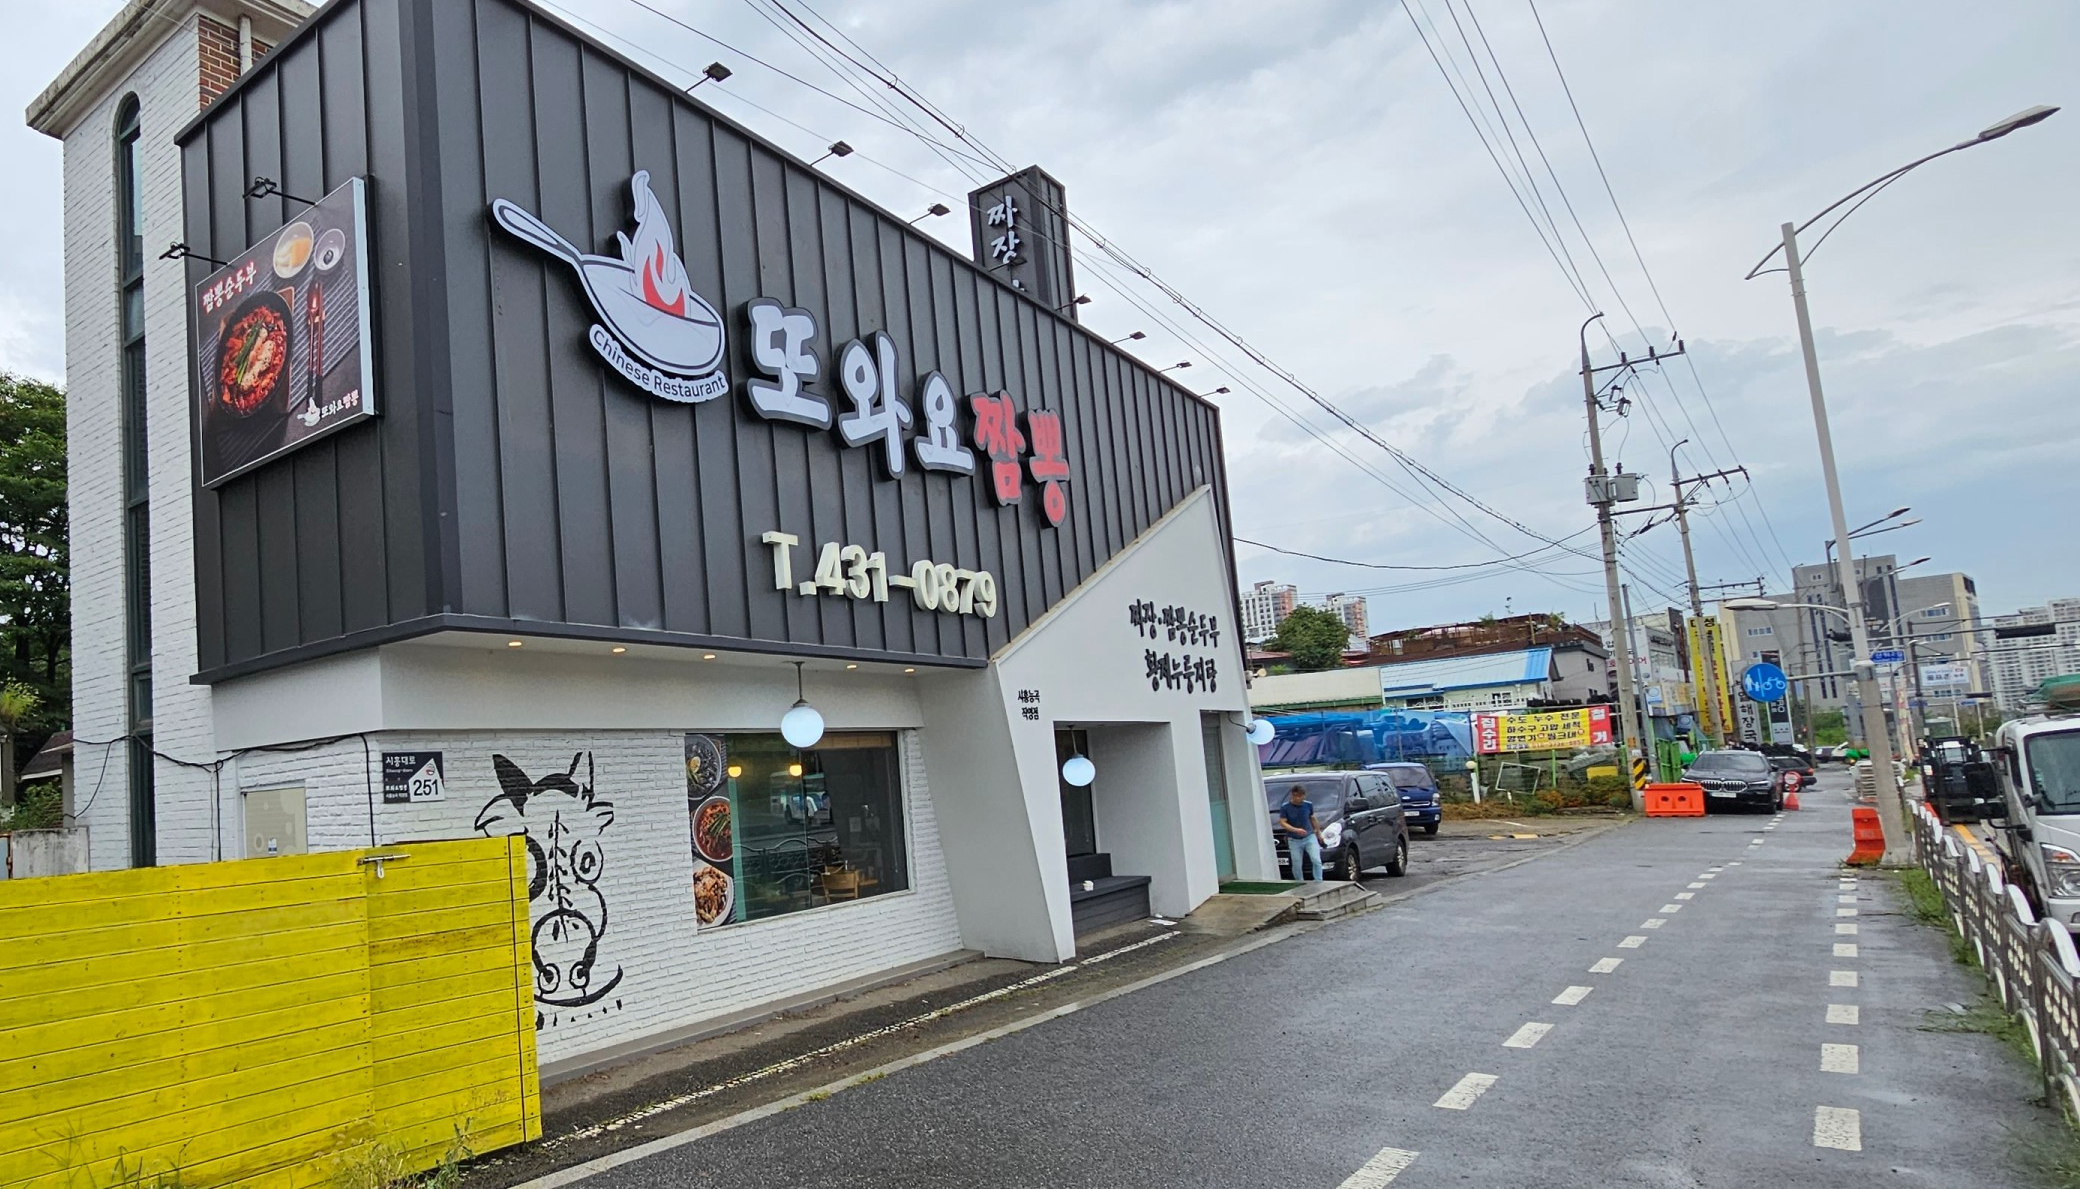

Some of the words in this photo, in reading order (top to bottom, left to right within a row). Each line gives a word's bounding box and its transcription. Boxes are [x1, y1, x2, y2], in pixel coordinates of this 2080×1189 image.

[202, 261, 257, 314] 짬뽕순두부
[594, 330, 650, 386] Chinese
[654, 375, 726, 397] Restaurant
[1017, 689, 1040, 703] 시흥능곡
[1506, 716, 1528, 724] 수도
[1534, 714, 1554, 722] 누수
[1506, 725, 1537, 733] 하수구
[385, 756, 416, 767] 시흥대로
[413, 779, 438, 796] 251
